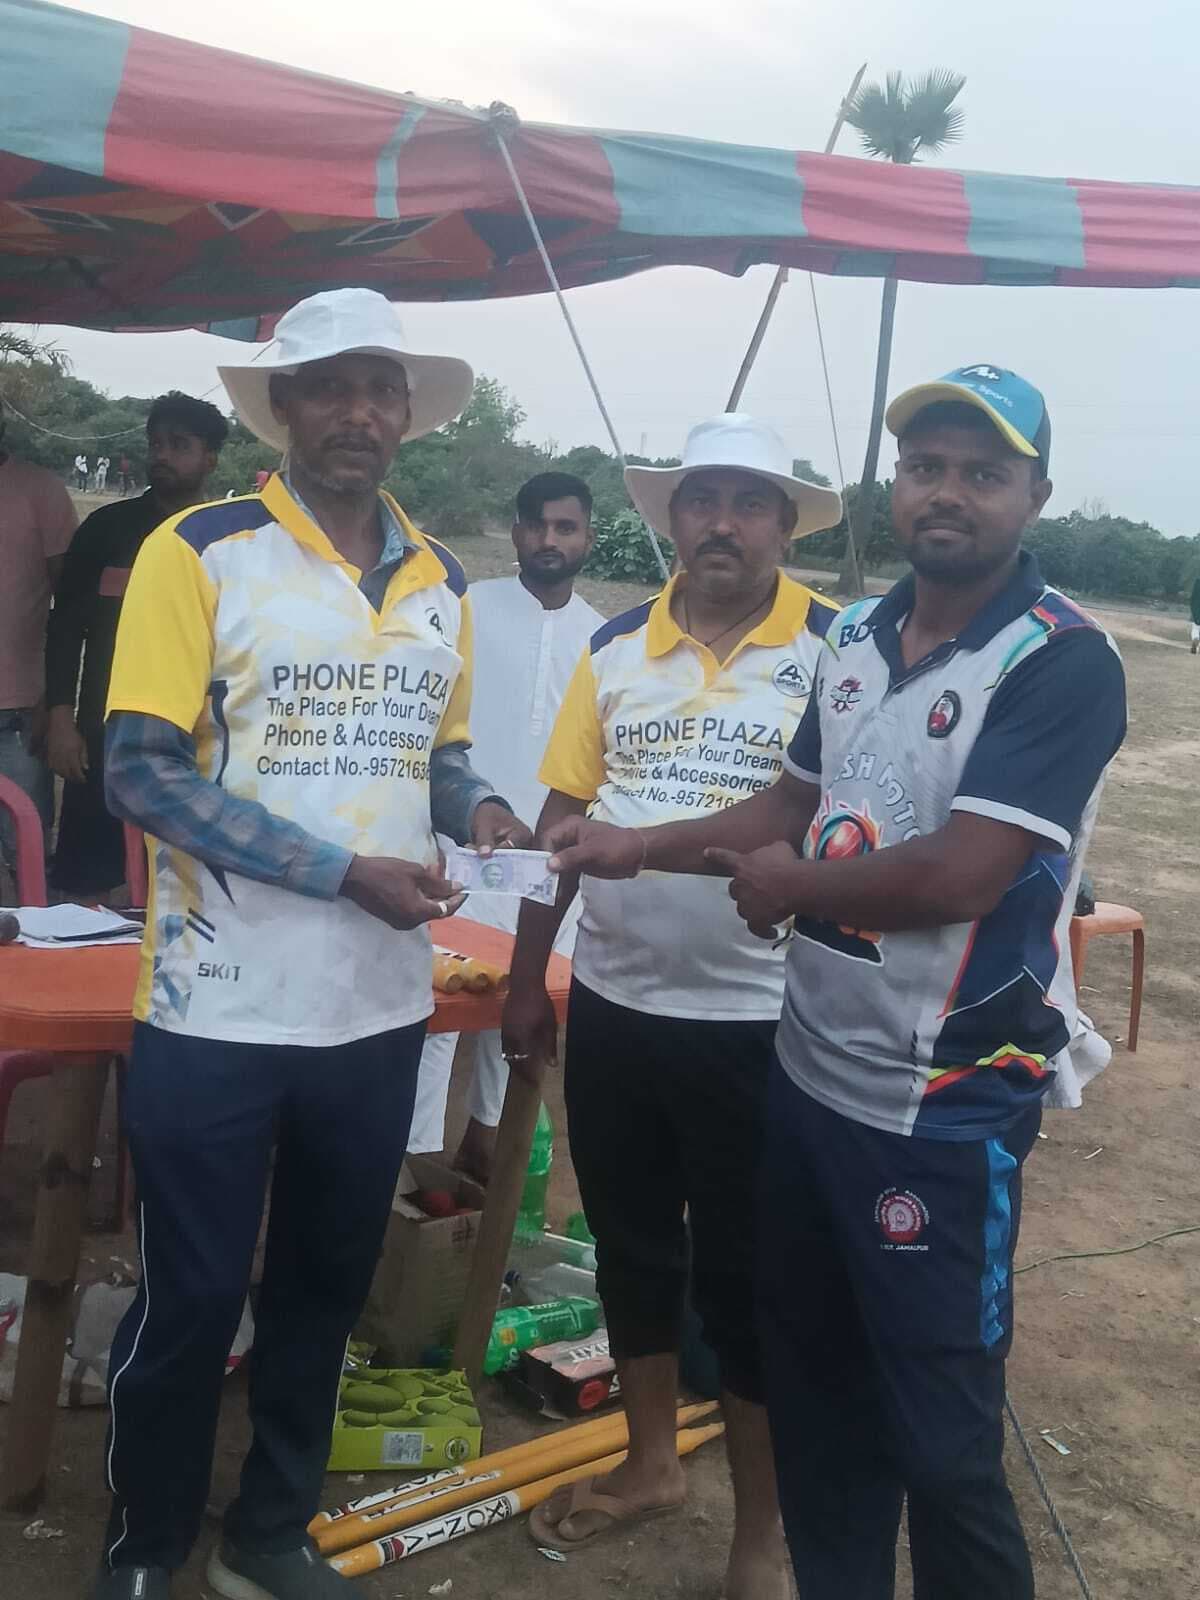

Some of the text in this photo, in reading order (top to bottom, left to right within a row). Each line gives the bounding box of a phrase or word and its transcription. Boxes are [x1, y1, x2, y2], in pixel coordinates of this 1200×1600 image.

[272, 663, 449, 705] PHONE PLAZA
[267, 697, 295, 717] The
[299, 697, 347, 717] Place
[352, 697, 378, 717] For
[382, 697, 415, 719] Your
[264, 723, 328, 747] Phone
[333, 723, 348, 747] &
[615, 717, 784, 751] PHONE PLAZA
[257, 756, 329, 777] Contact
[637, 748, 672, 765] Place
[698, 743, 730, 764] Your
[733, 748, 783, 772] Dream
[833, 752, 877, 782] SH
[651, 766, 663, 780] &
[646, 785, 743, 809] No.-957216
[404, 1498, 505, 1555] VINOX
